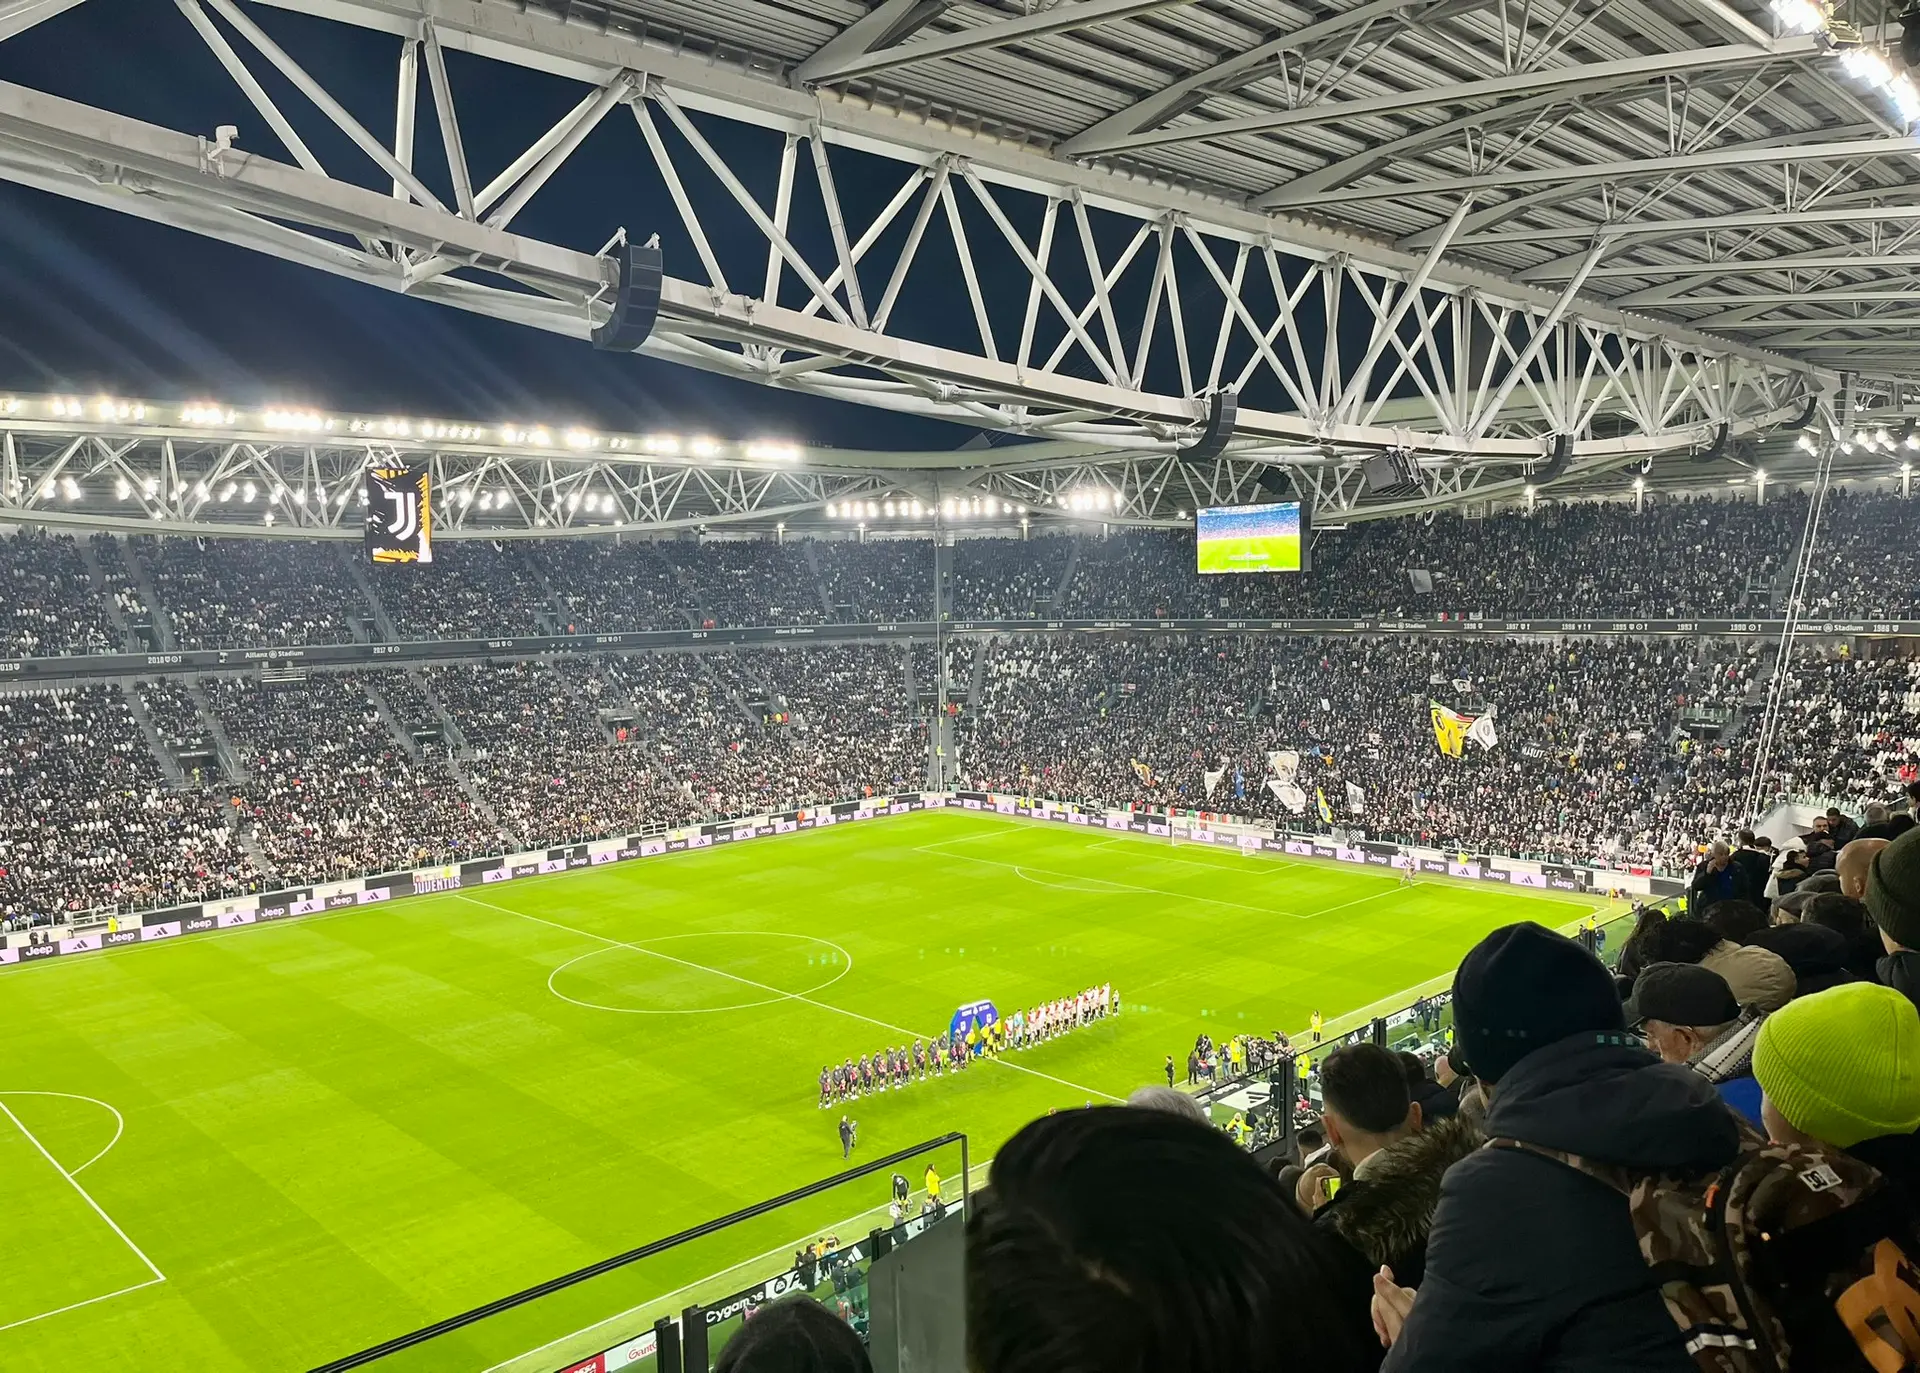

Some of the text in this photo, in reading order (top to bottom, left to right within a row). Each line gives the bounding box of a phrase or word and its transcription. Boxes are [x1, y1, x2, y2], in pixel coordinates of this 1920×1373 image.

[1405, 622, 1426, 630] Stadium
[1834, 624, 1864, 632] Stadium
[245, 650, 304, 659] Allianz Stadium
[0, 663, 13, 671] 019
[669, 840, 686, 850] Jeep
[1265, 840, 1281, 850] Jeep
[620, 848, 638, 858] Jeep
[1315, 847, 1333, 857] Jeep
[570, 857, 588, 867] Jeep
[1368, 854, 1387, 864] Jeep
[515, 865, 535, 876] Jeep
[1424, 860, 1445, 873] Jeep
[1484, 869, 1506, 881] Jeep
[413, 876, 461, 895] JUVENTUS
[1551, 877, 1575, 890] Jeep
[330, 896, 352, 906] Jeep
[261, 906, 285, 918] Jeep
[187, 918, 212, 930] Jeep
[108, 931, 135, 943] Jeep
[25, 944, 54, 957] Jeep
